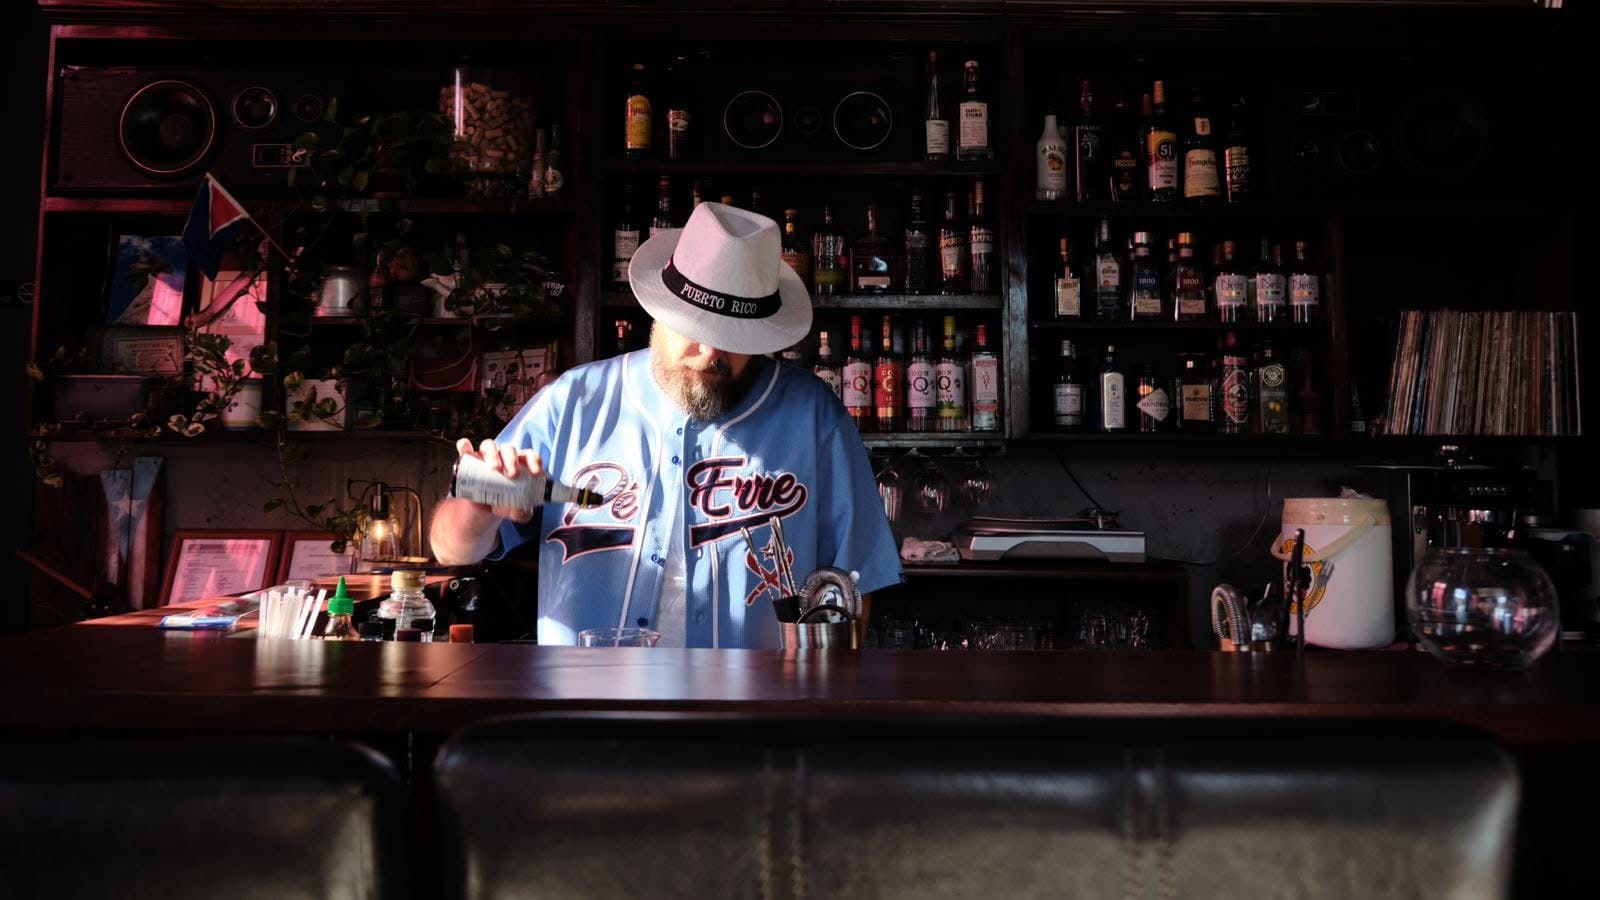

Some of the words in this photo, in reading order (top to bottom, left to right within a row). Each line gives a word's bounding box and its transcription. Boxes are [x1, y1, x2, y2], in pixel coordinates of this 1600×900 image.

[1160, 144, 1173, 157] 51
[1139, 277, 1156, 285] 1800
[680, 283, 725, 310] PUERTO
[731, 300, 757, 315] RICO
[853, 376, 868, 395] Q
[913, 376, 929, 395] Q
[938, 375, 952, 393] Q
[562, 461, 639, 525] Pé
[686, 456, 808, 519] Erre
